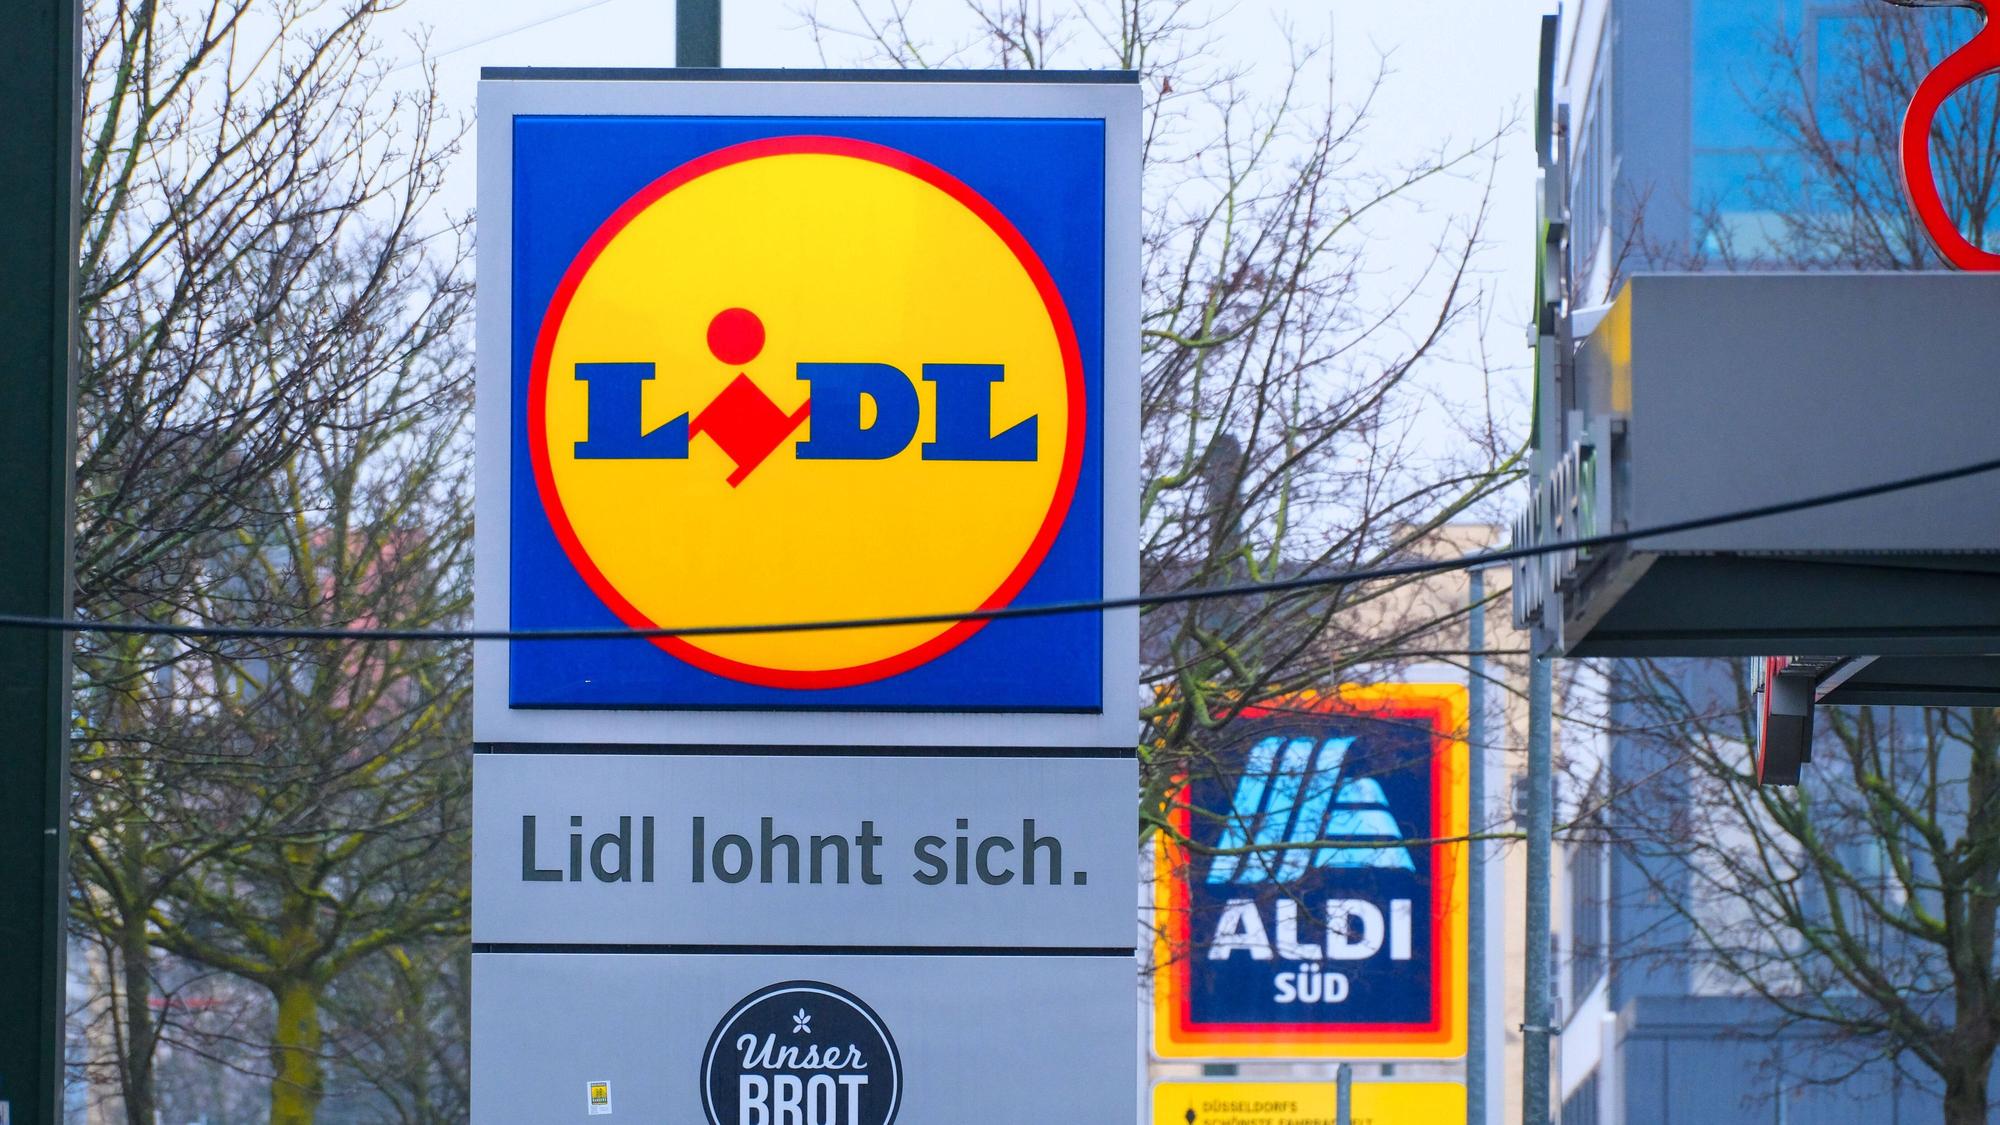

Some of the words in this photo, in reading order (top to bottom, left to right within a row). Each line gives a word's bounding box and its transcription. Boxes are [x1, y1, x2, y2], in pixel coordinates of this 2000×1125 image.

[521, 815, 655, 883] Lidl
[692, 815, 883, 885] lohnt
[912, 817, 1088, 886] sich.
[1208, 898, 1412, 961] ALDI
[1273, 962, 1350, 1004] SÜD
[736, 1032, 868, 1070] Unser
[739, 1073, 869, 1125] BROT
